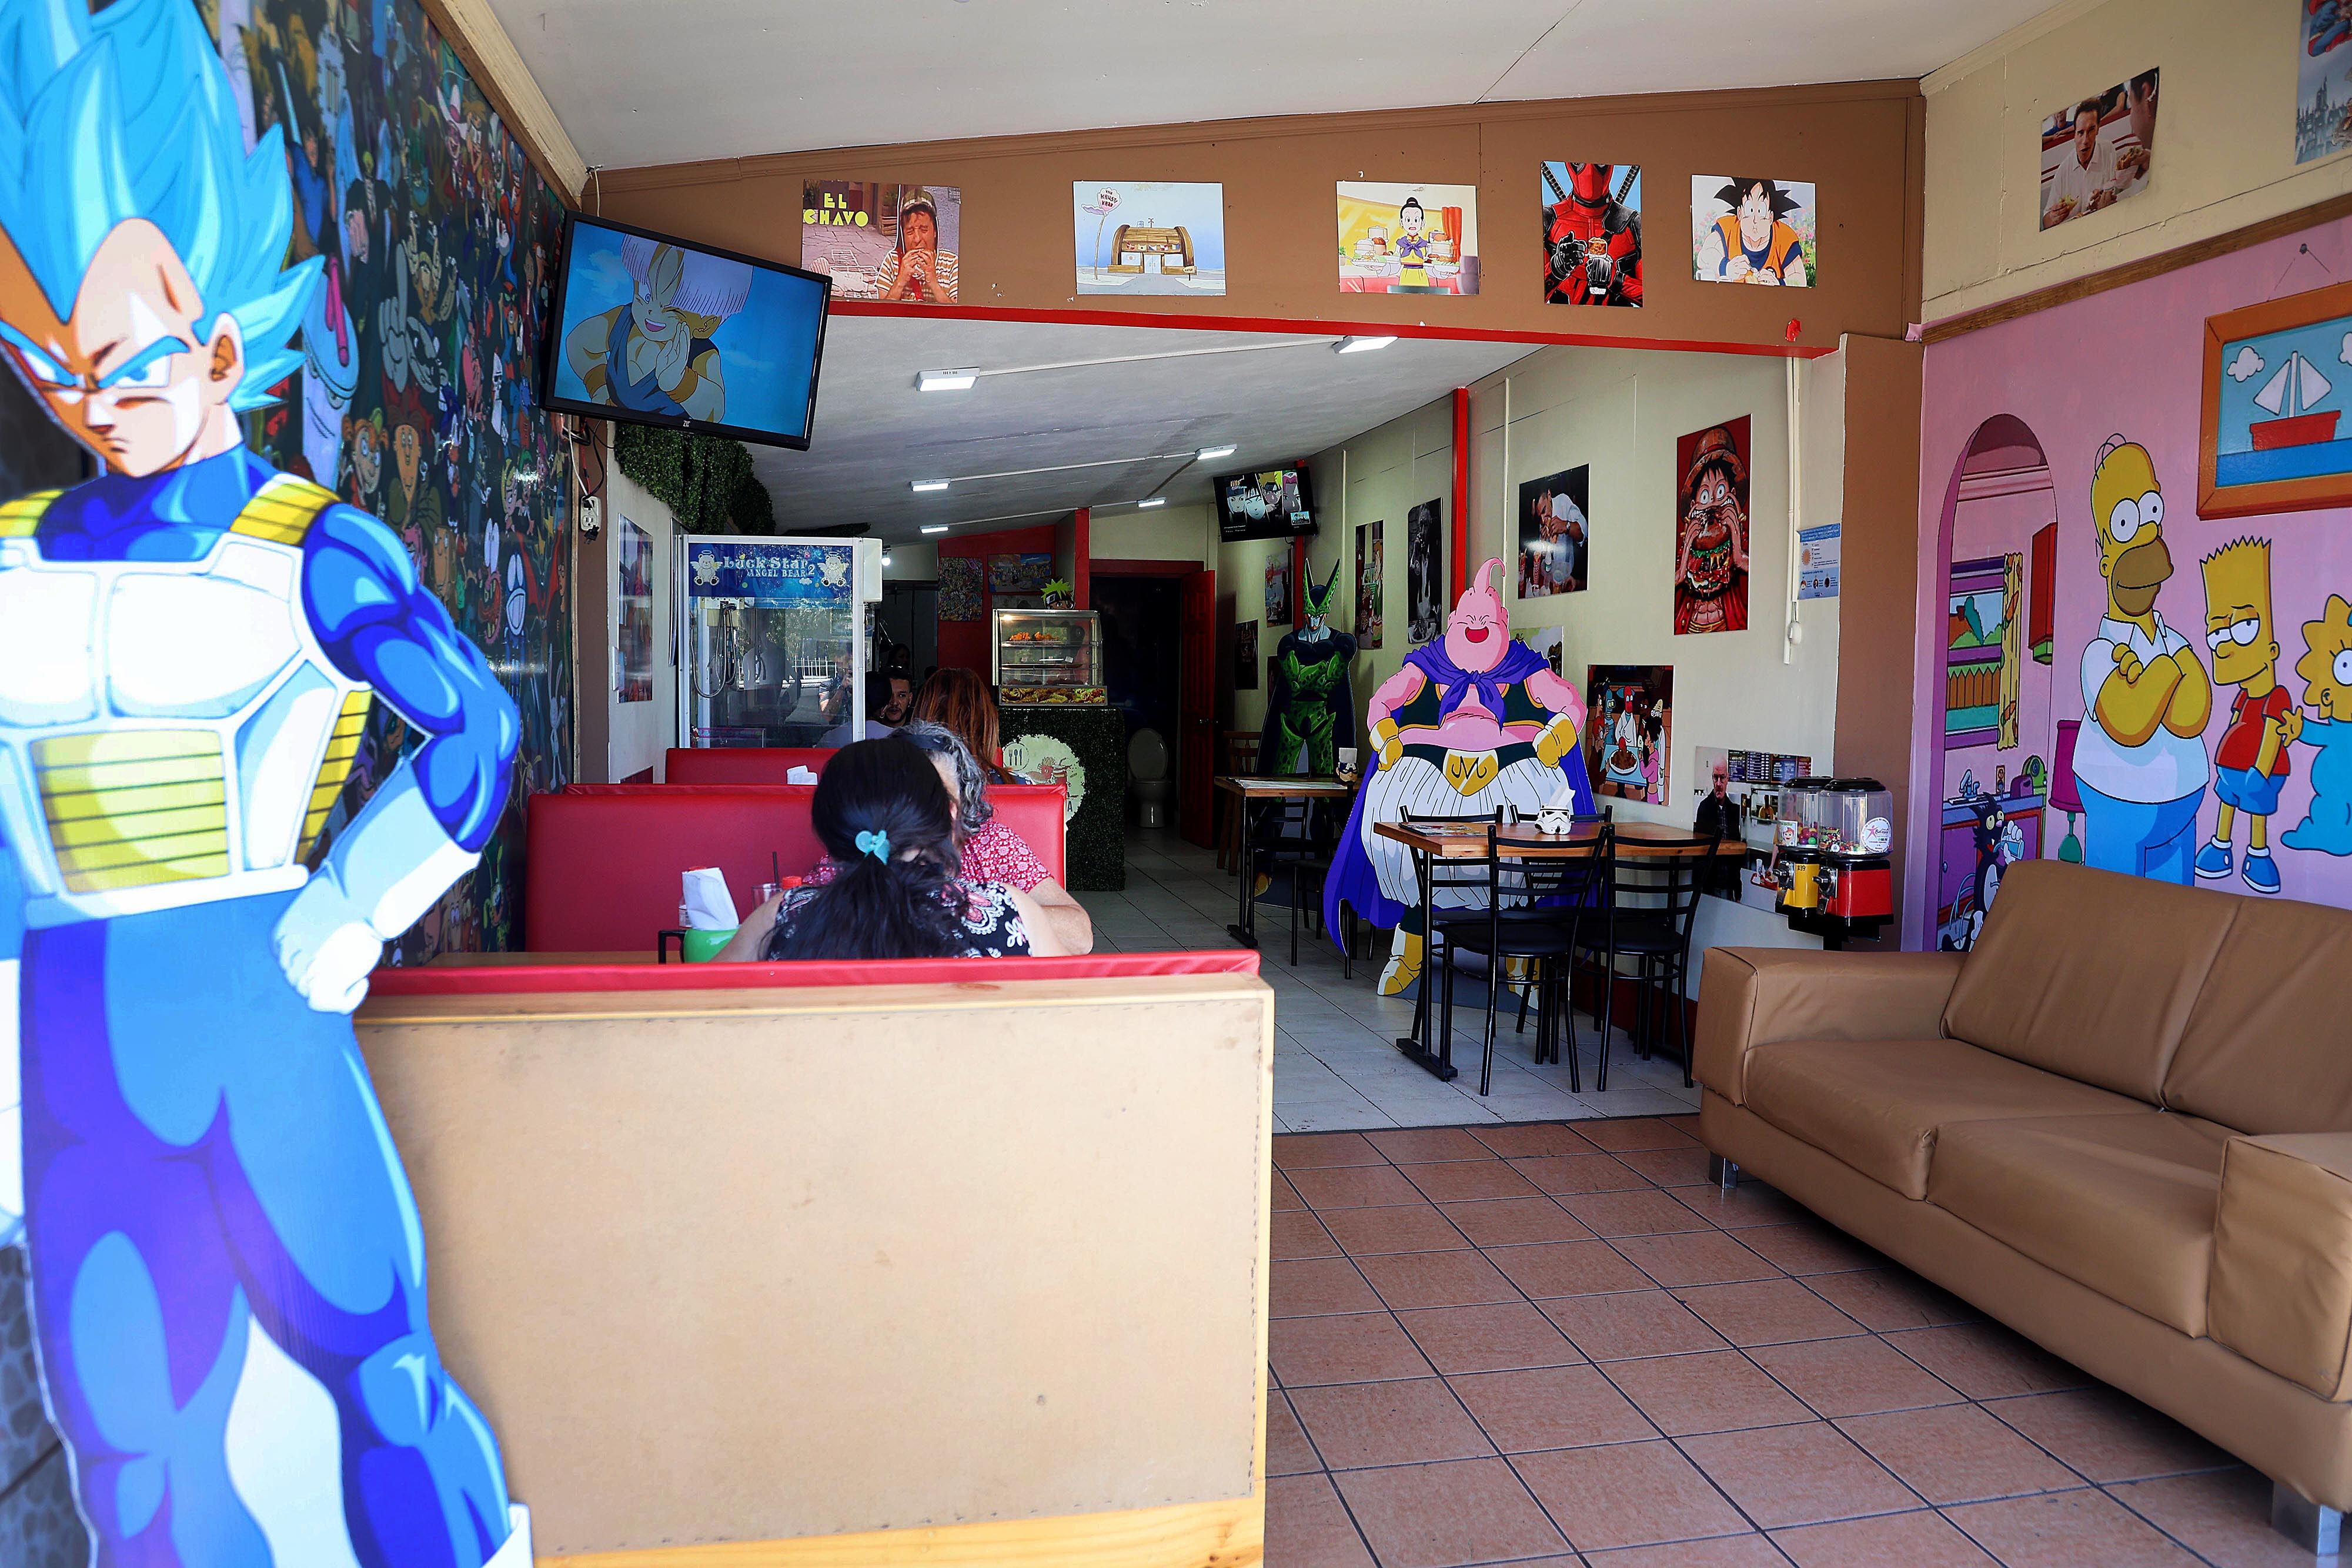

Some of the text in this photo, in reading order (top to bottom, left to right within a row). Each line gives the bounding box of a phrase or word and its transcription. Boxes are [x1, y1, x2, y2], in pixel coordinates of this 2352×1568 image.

[824, 192, 847, 209] EL
[1100, 193, 1118, 204] KRUSTY
[803, 208, 869, 228] CHAVO
[724, 556, 816, 576] Luck Star 2
